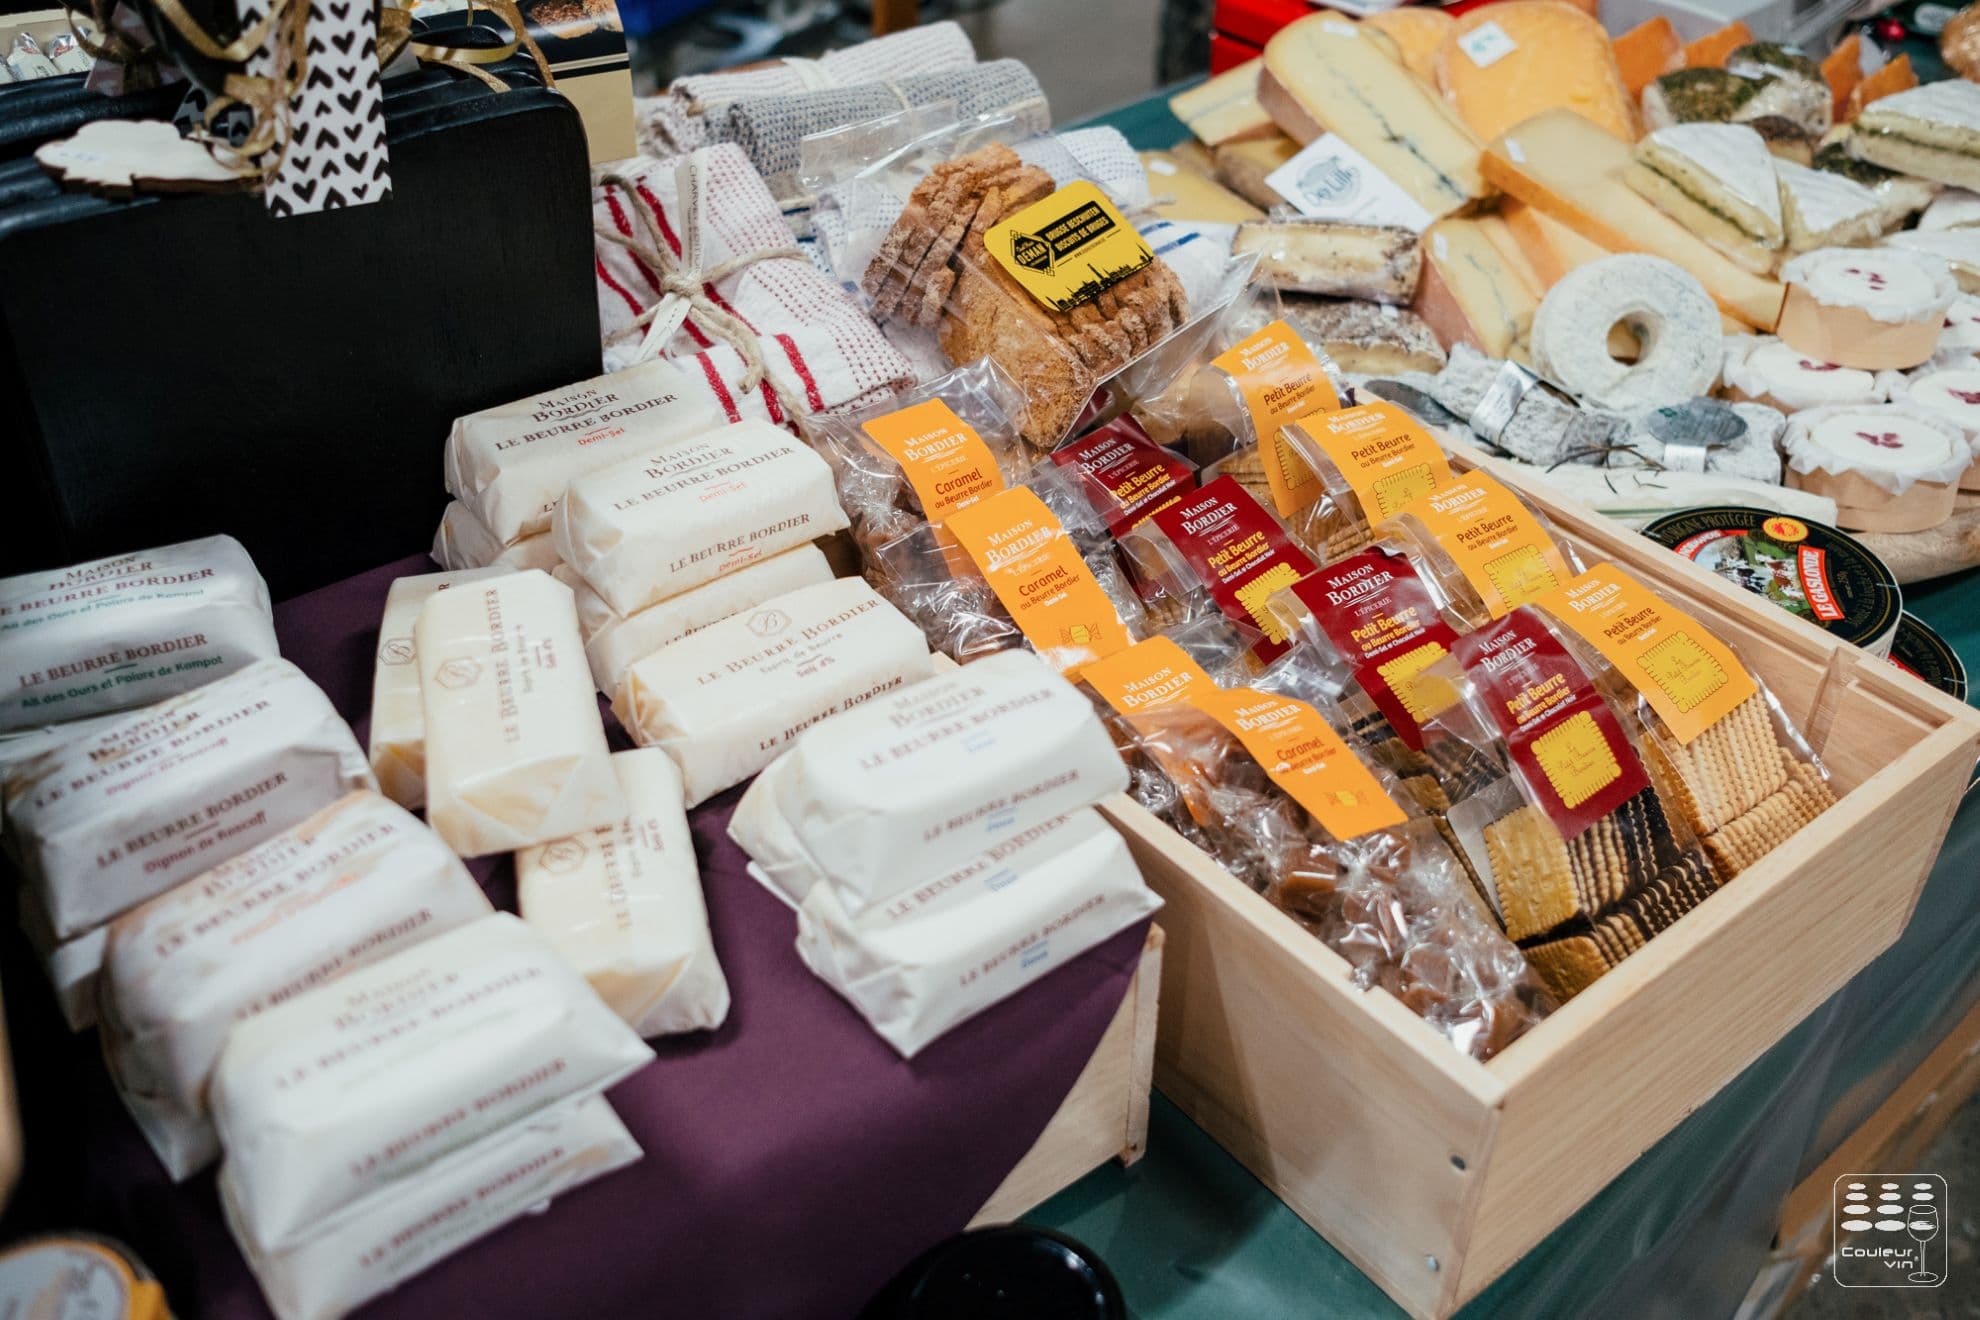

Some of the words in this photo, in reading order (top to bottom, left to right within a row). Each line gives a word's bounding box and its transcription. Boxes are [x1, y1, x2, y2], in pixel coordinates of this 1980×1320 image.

[1017, 243, 1047, 265] DEMAN
[1242, 342, 1290, 371] BORDIER
[538, 388, 599, 410] MAISON
[1263, 386, 1286, 406] Petit
[1284, 373, 1313, 395] Beurre
[495, 439, 521, 451] LE
[523, 417, 597, 444] BEURRE
[599, 394, 680, 423] BORDIER
[531, 393, 620, 423] BORDIER
[577, 427, 625, 446] Demi-Sel
[904, 427, 948, 447] MAISON
[904, 433, 969, 462] BORDIER
[1078, 437, 1117, 461] MAISON
[1351, 443, 1377, 461] Petit
[1377, 433, 1411, 451] Beurre
[643, 447, 734, 479] BORDIER
[651, 443, 710, 465] MAISON
[1079, 442, 1136, 475] BORDIER
[614, 499, 640, 511] LE
[641, 474, 715, 502] BEURRE
[715, 446, 796, 477] BORDIER
[935, 467, 983, 495] Caramel
[1128, 486, 1150, 504] Beurre
[1147, 473, 1170, 492] Bordier
[1131, 464, 1165, 487] Beurre
[934, 500, 945, 509] au
[944, 490, 969, 505] Beurre
[967, 478, 993, 497] Bordier
[1180, 496, 1219, 520] MAISON
[1429, 487, 1487, 513] BORDIER
[987, 519, 1033, 546] MAISON
[1181, 502, 1238, 536] BORDIER
[1456, 525, 1482, 545] Petit
[1481, 513, 1514, 535] Beurre
[670, 557, 688, 573] LE
[690, 535, 745, 564] BEURRE
[749, 513, 810, 542] BORDIER
[984, 526, 1052, 564] BORDIER
[1207, 547, 1233, 569] Petit
[1230, 530, 1265, 554] Beurre
[1218, 567, 1229, 578] au
[1226, 553, 1249, 573] Beurre
[1246, 542, 1270, 560] Bordier
[19, 587, 110, 612] BEURRE
[115, 568, 216, 591] BORDIER
[1018, 565, 1069, 597] Caramel
[1020, 600, 1032, 610] au
[1030, 586, 1056, 605] Beurre
[1053, 573, 1081, 594] Bordier
[1325, 570, 1394, 607] BORDIER
[1327, 563, 1374, 590] MAISON
[1802, 550, 1829, 606] GASLONDE
[486, 588, 510, 654] BORDIER
[1351, 621, 1380, 643] Petit
[1378, 606, 1417, 632] Beurre
[1603, 619, 1629, 639] Petit
[1623, 607, 1655, 628] Beurre
[697, 670, 722, 686] LE
[725, 638, 798, 673] BEURRE
[801, 598, 880, 641] BORDIER
[1361, 641, 1372, 652] au
[1369, 630, 1396, 650] Beurre
[1479, 630, 1517, 656] MAISON
[1480, 637, 1537, 673] BORDIER
[19, 672, 45, 689] LE
[47, 651, 122, 682] BEURRE
[126, 633, 208, 661] BORDIER
[1121, 671, 1193, 710] BORDIER
[1122, 667, 1173, 694] MAISON
[1506, 692, 1532, 715] Petit
[1527, 673, 1566, 701] Beurre
[759, 736, 779, 751] LE
[843, 675, 904, 711] BORDIER
[1234, 703, 1301, 733] BORDIER
[1277, 736, 1324, 761] Caramel
[206, 771, 288, 820] BORDIER
